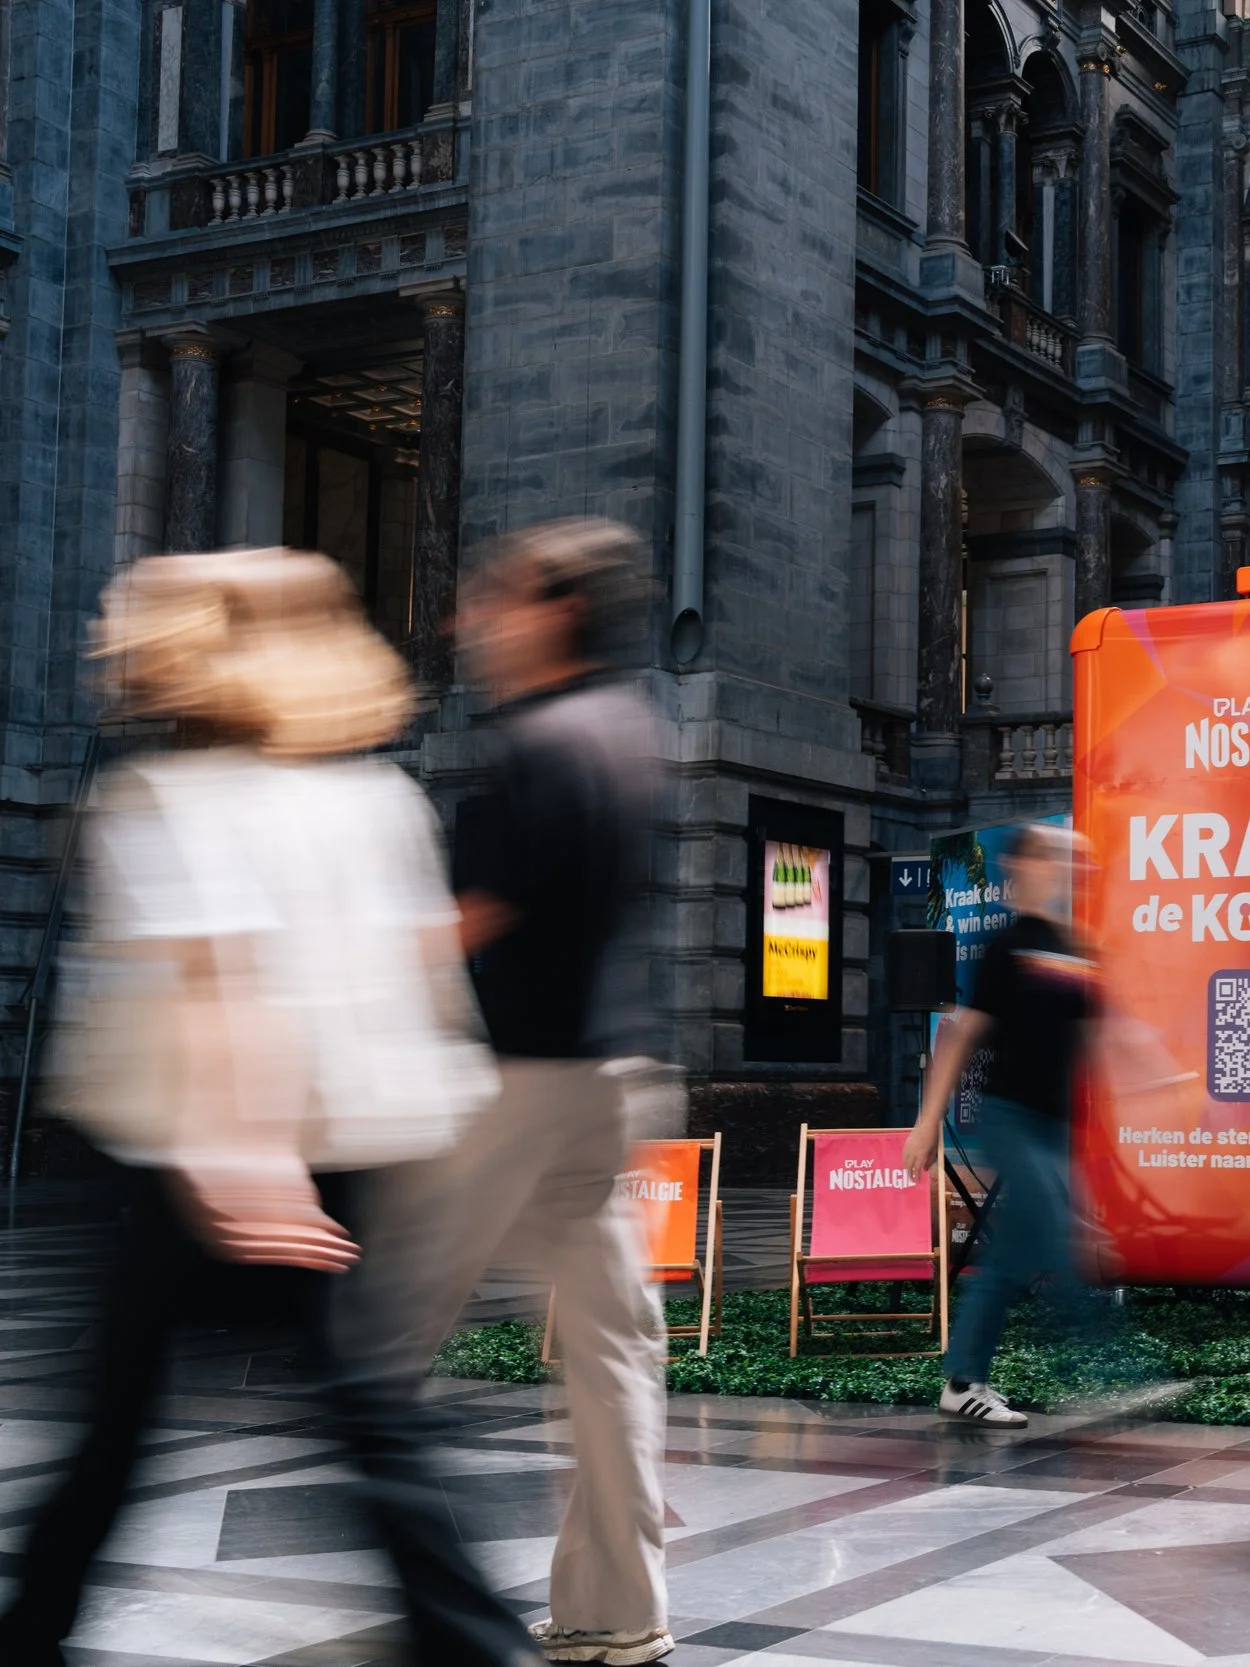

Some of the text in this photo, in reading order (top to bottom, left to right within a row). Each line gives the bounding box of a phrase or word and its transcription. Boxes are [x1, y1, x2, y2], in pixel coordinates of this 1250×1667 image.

[945, 884, 981, 908] Kraak
[984, 882, 1000, 902] de
[945, 915, 955, 933] &
[958, 912, 981, 933] win
[983, 911, 1007, 931] een
[1132, 895, 1184, 932] de
[1118, 1126, 1185, 1144] Herken
[1188, 1127, 1213, 1145] de
[844, 1159, 874, 1169] PLAY
[1138, 1149, 1207, 1168] Luister
